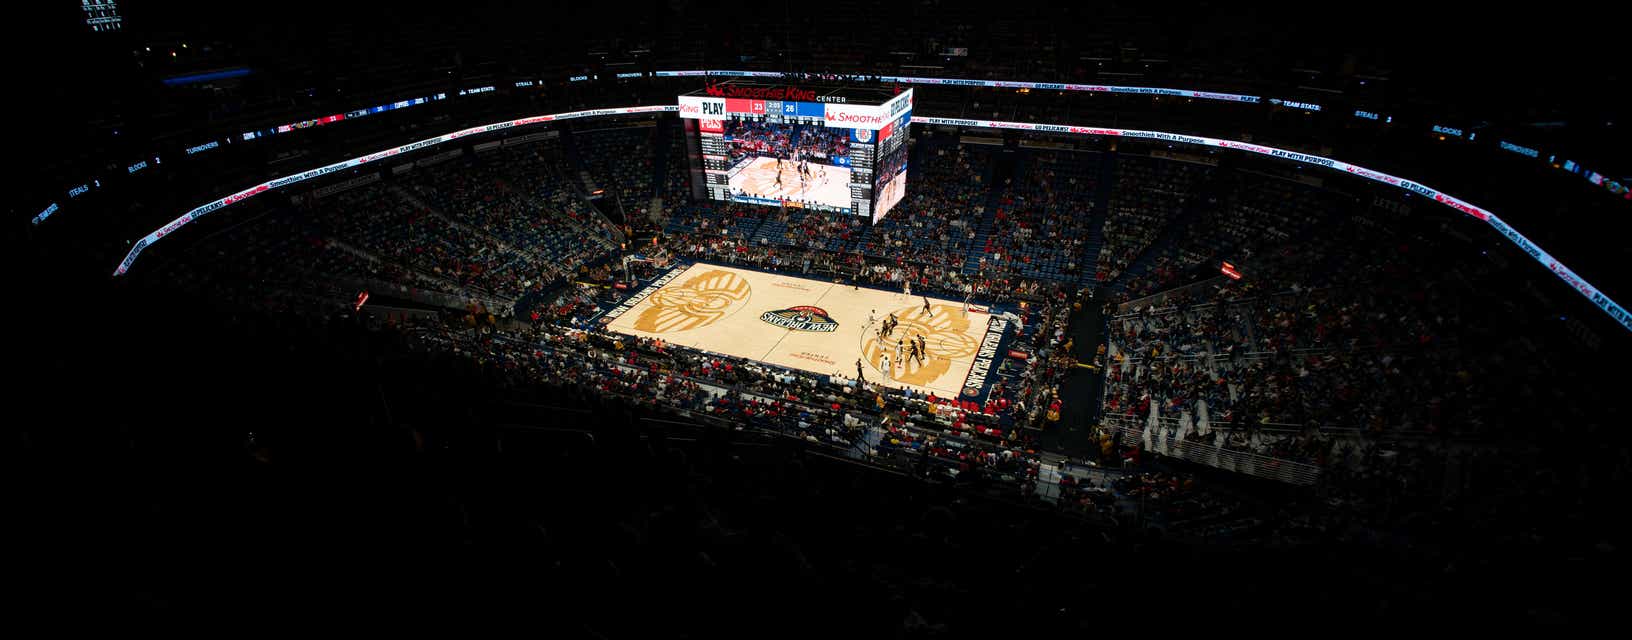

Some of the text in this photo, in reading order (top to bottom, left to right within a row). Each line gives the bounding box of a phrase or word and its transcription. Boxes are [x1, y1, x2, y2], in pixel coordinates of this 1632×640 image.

[786, 86, 816, 101] KING
[702, 102, 724, 115] PLAY
[754, 103, 763, 111] 23
[1287, 152, 1304, 160] WITH
[270, 175, 304, 188] Smoothies
[304, 170, 319, 179] With
[324, 163, 348, 174] Purpose
[762, 312, 837, 332] NEW ORLEANS
